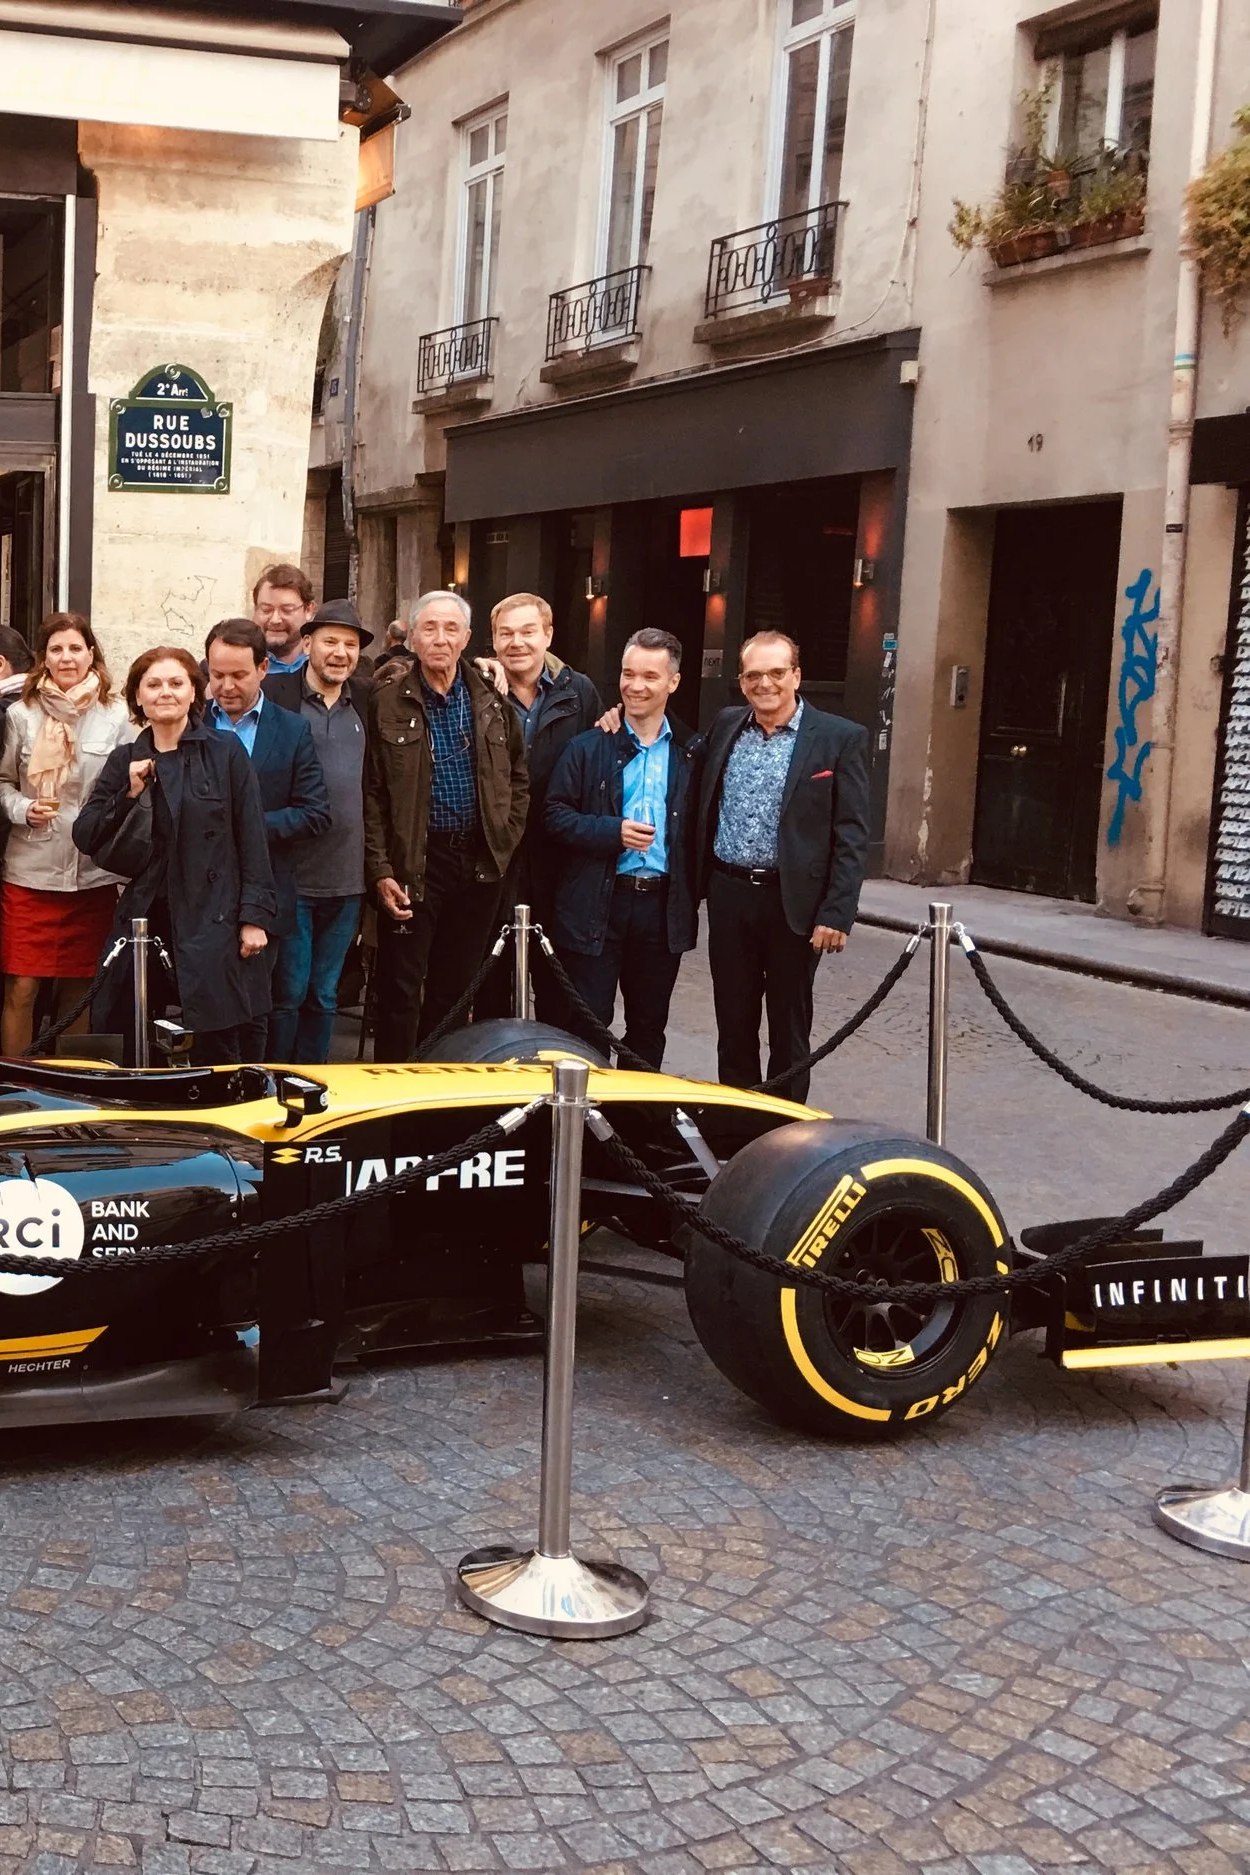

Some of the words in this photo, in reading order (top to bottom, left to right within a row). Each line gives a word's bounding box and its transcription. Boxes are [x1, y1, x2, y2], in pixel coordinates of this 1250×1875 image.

[153, 414, 190, 431] RUE
[125, 432, 216, 451] DUSSOUBS
[1028, 433, 1044, 452] 19
[91, 1201, 150, 1218] BANK
[92, 1223, 139, 1241] AND
[1094, 1275, 1245, 1308] INFINITI
[8, 1359, 71, 1373] HECHTER
